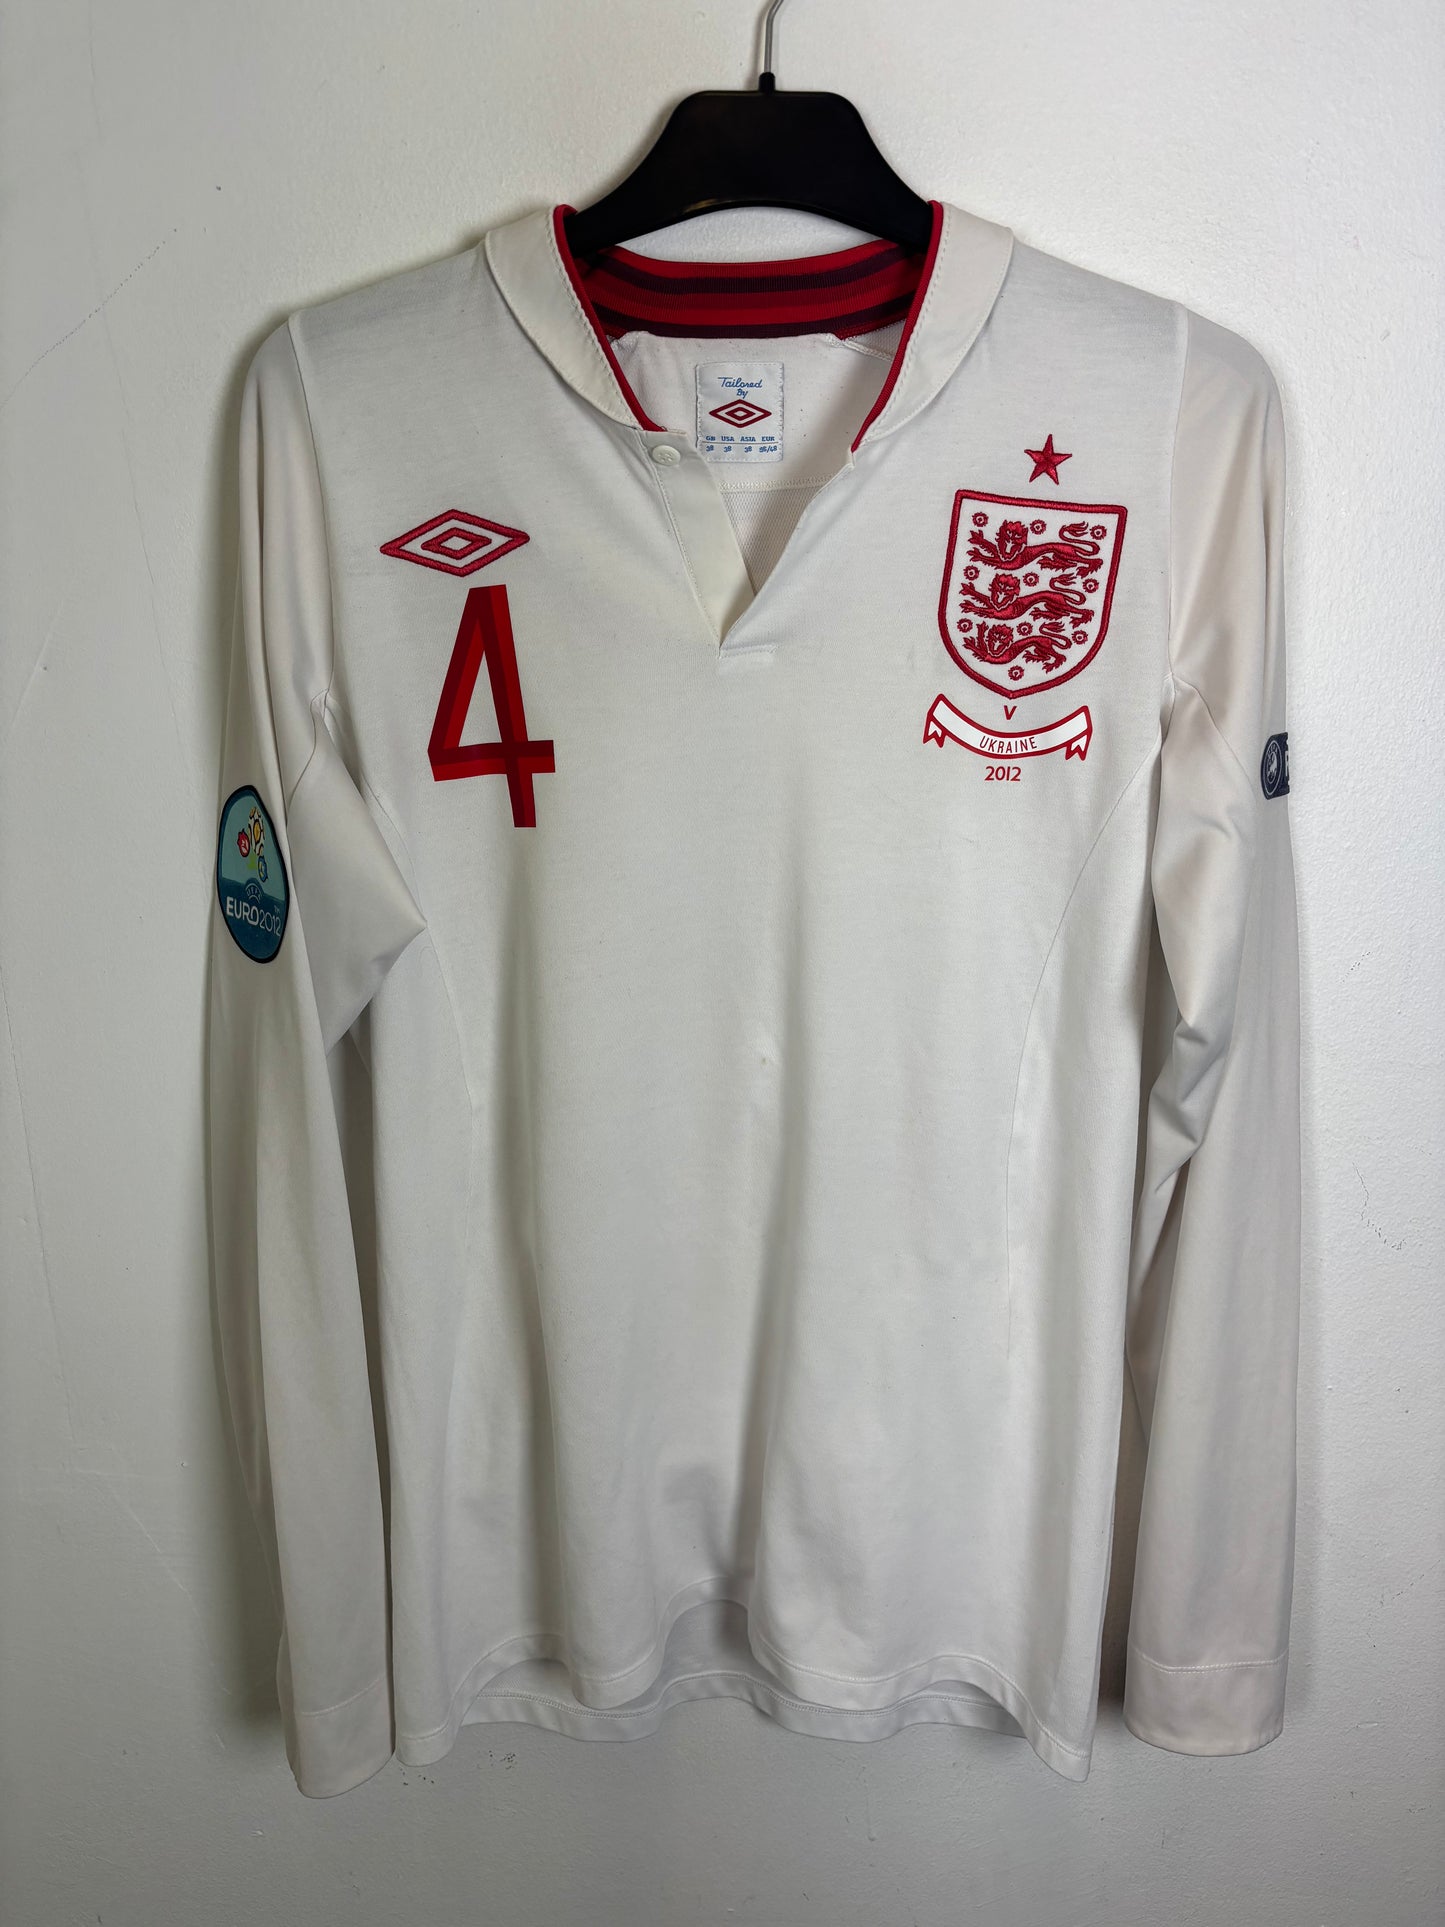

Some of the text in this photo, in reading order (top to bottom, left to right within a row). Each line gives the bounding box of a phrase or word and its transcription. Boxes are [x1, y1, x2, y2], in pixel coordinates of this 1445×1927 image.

[718, 377, 762, 388] Tailored
[737, 388, 748, 399] By
[427, 584, 556, 828] 4
[979, 735, 1038, 754] UKRAINE
[984, 765, 1022, 782] 2012
